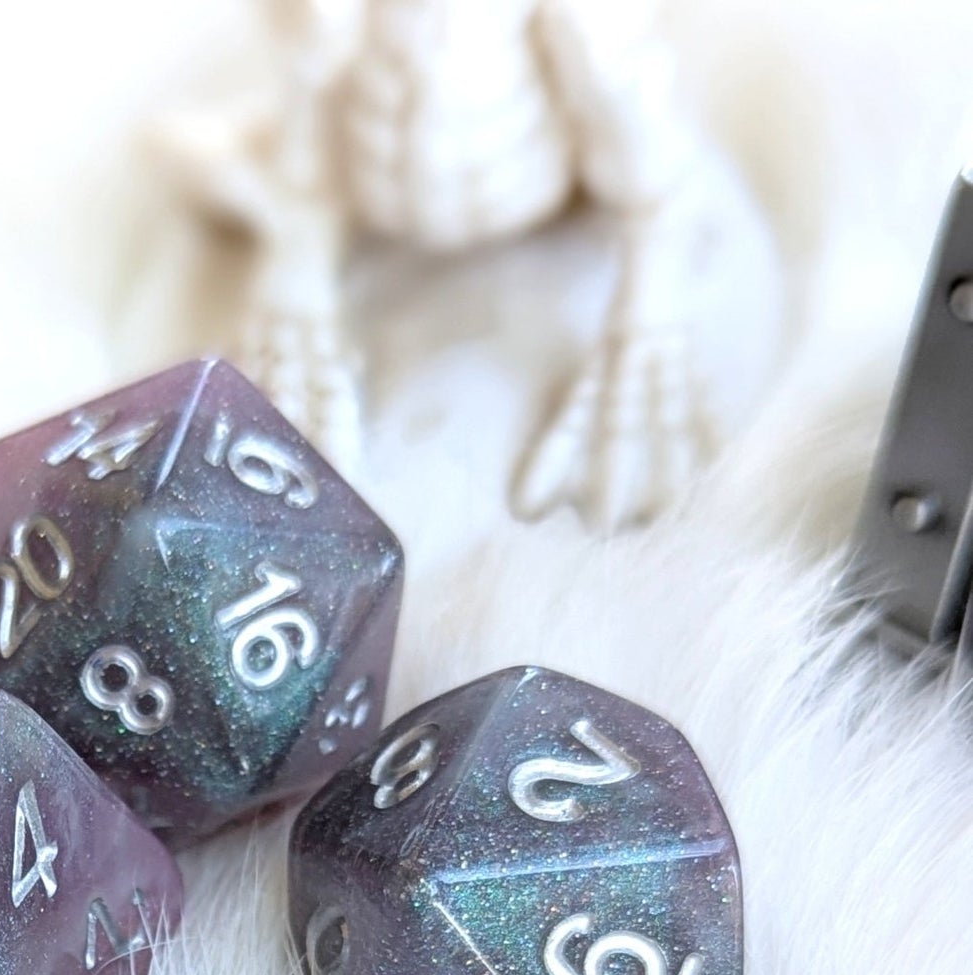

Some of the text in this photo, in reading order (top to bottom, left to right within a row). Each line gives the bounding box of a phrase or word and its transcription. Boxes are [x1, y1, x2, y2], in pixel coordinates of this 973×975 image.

[214, 561, 319, 690] 16
[80, 644, 175, 736] 8
[507, 720, 642, 822] 2
[11, 779, 59, 908] 4
